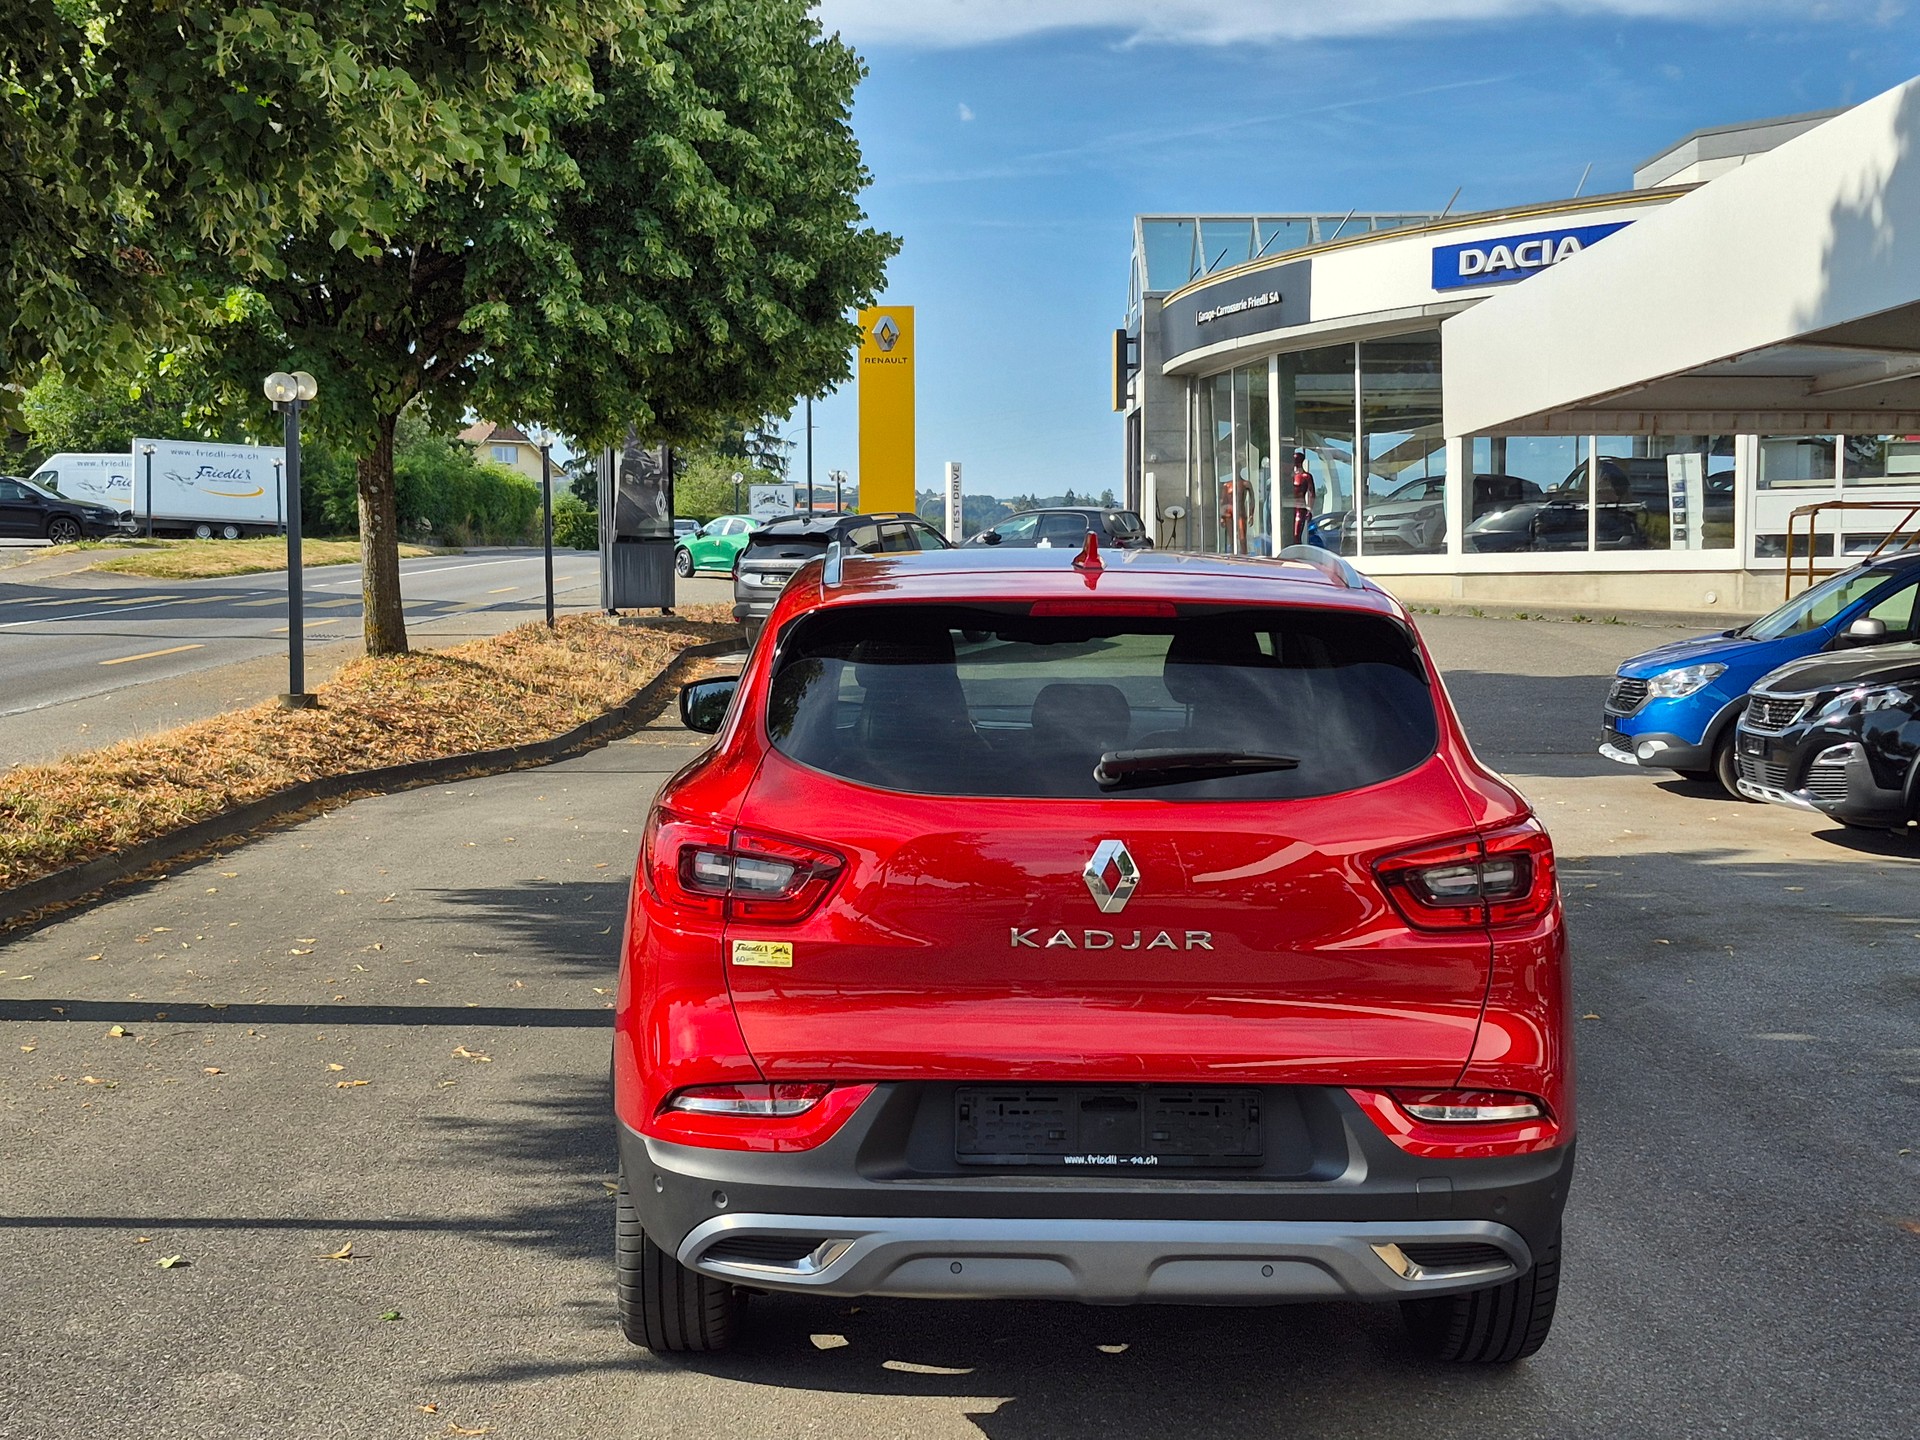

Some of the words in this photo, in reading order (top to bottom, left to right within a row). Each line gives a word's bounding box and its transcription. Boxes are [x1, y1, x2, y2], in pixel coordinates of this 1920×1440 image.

[1458, 236, 1584, 276] DACIA
[1269, 291, 1280, 304] SA
[1010, 927, 1214, 950] KADJAR
